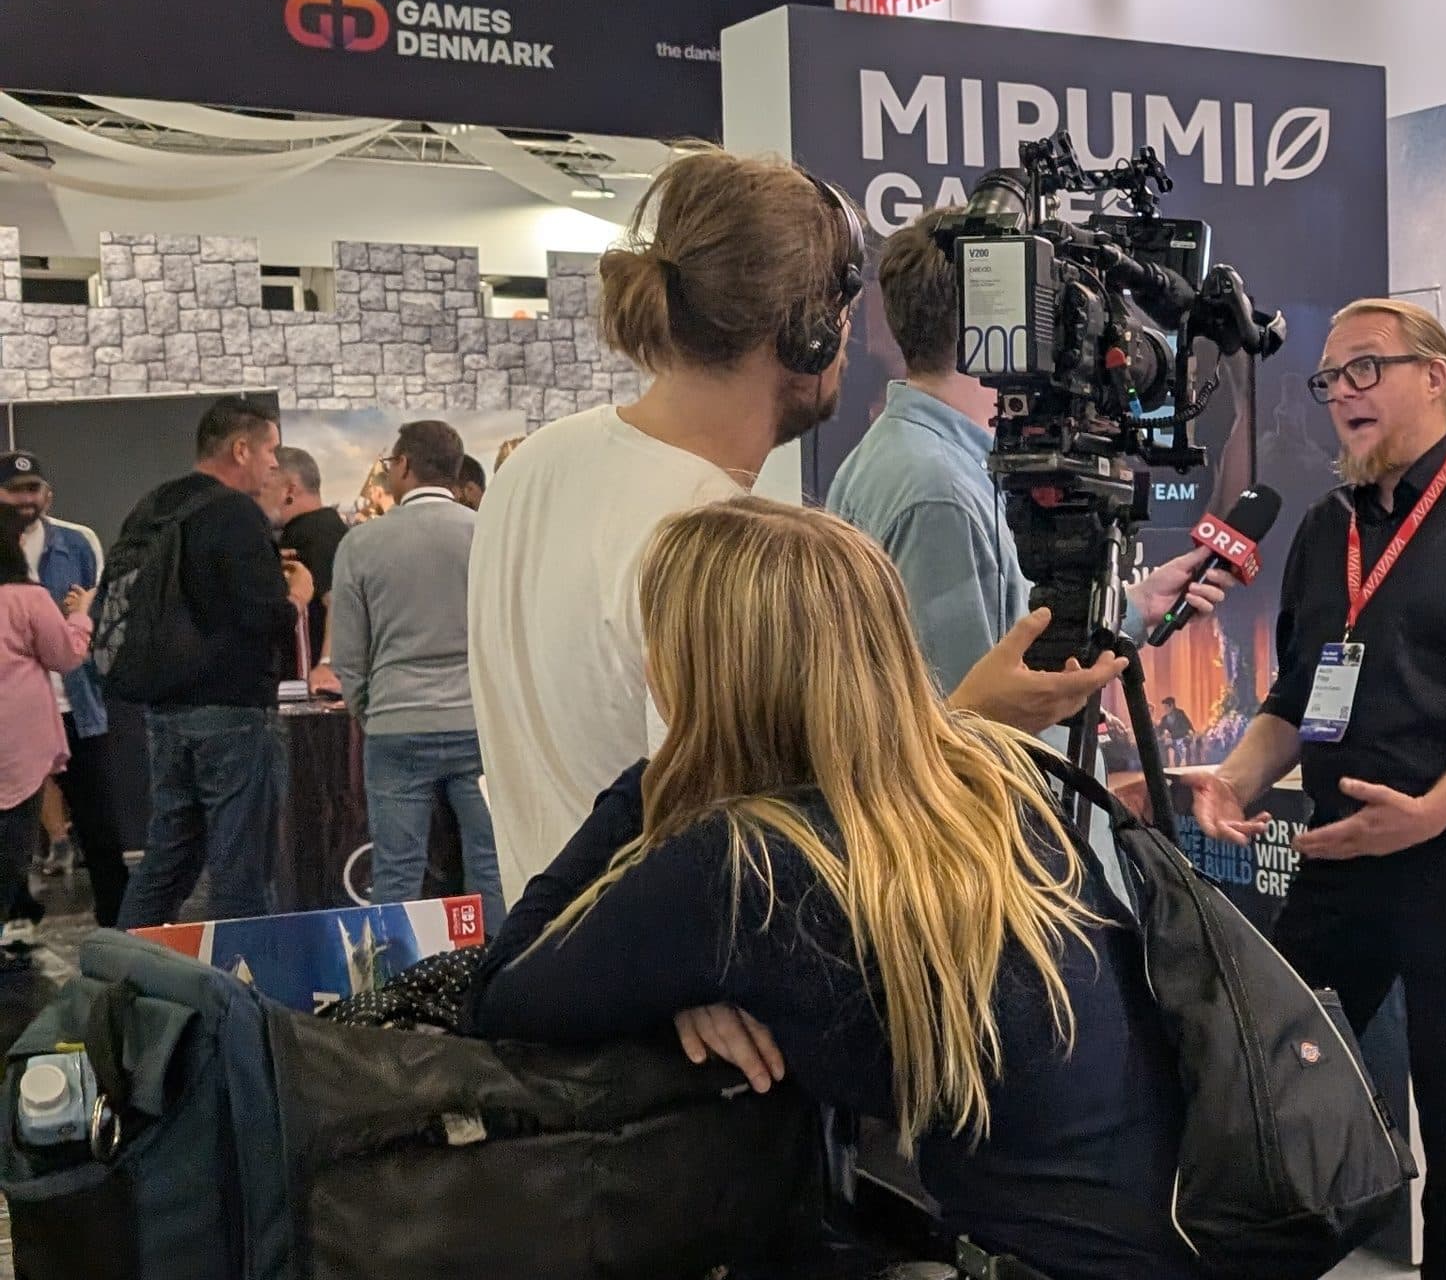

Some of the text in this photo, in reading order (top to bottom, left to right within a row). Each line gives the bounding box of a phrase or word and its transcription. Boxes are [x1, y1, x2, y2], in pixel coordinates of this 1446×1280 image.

[396, 0, 512, 34] GAMES
[396, 30, 555, 70] DENMARK
[656, 42, 681, 58] the
[860, 69, 1254, 187] MIPUMI
[864, 172, 1134, 238] GAES
[969, 248, 990, 259] V200
[963, 324, 1028, 373] 200
[1151, 482, 1195, 501] EAM
[1198, 521, 1247, 556] ORF
[1256, 820, 1290, 845] OR
